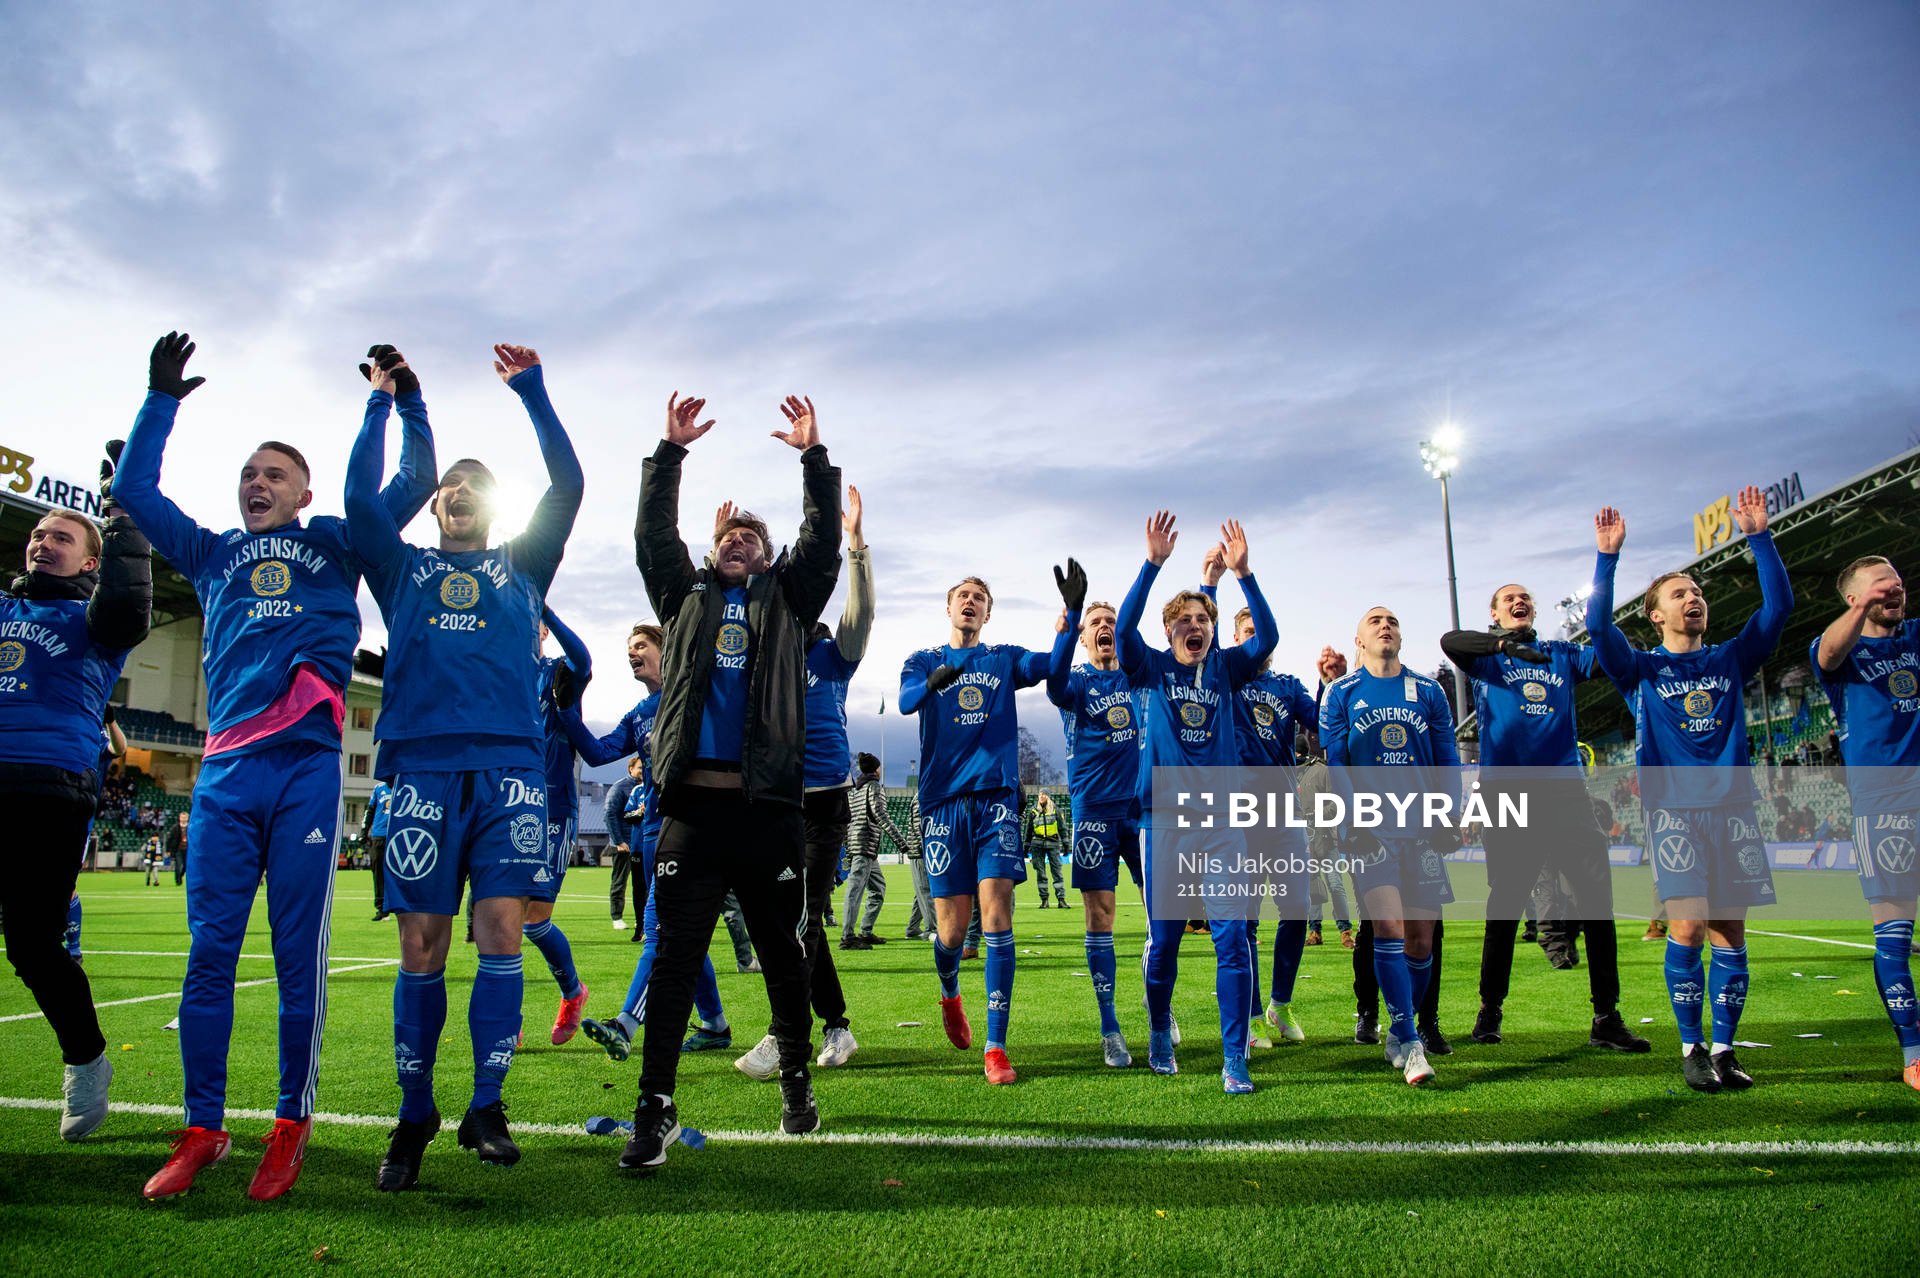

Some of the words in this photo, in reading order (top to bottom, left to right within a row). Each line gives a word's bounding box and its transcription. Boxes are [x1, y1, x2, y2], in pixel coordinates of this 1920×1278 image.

[35, 476, 107, 518] AREN
[1694, 495, 1733, 555] NP3
[1763, 472, 1805, 518] ENA
[223, 537, 328, 582] ALLSVENSKAN
[256, 600, 292, 619] 2022
[440, 613, 477, 631] 2022
[0, 621, 69, 658] VENSKAN
[716, 654, 747, 669] 2022
[1526, 704, 1548, 715] 2022
[961, 712, 985, 725] 2022
[1354, 707, 1429, 734] ALLSVENSKAN
[1688, 718, 1716, 732] 2022
[1112, 729, 1134, 743] 2022
[1180, 728, 1206, 742] 2022
[1383, 752, 1408, 764] 2022
[500, 777, 545, 808] Diös
[394, 784, 444, 821] Diös
[657, 861, 678, 877] BC
[395, 1056, 422, 1071] tc
